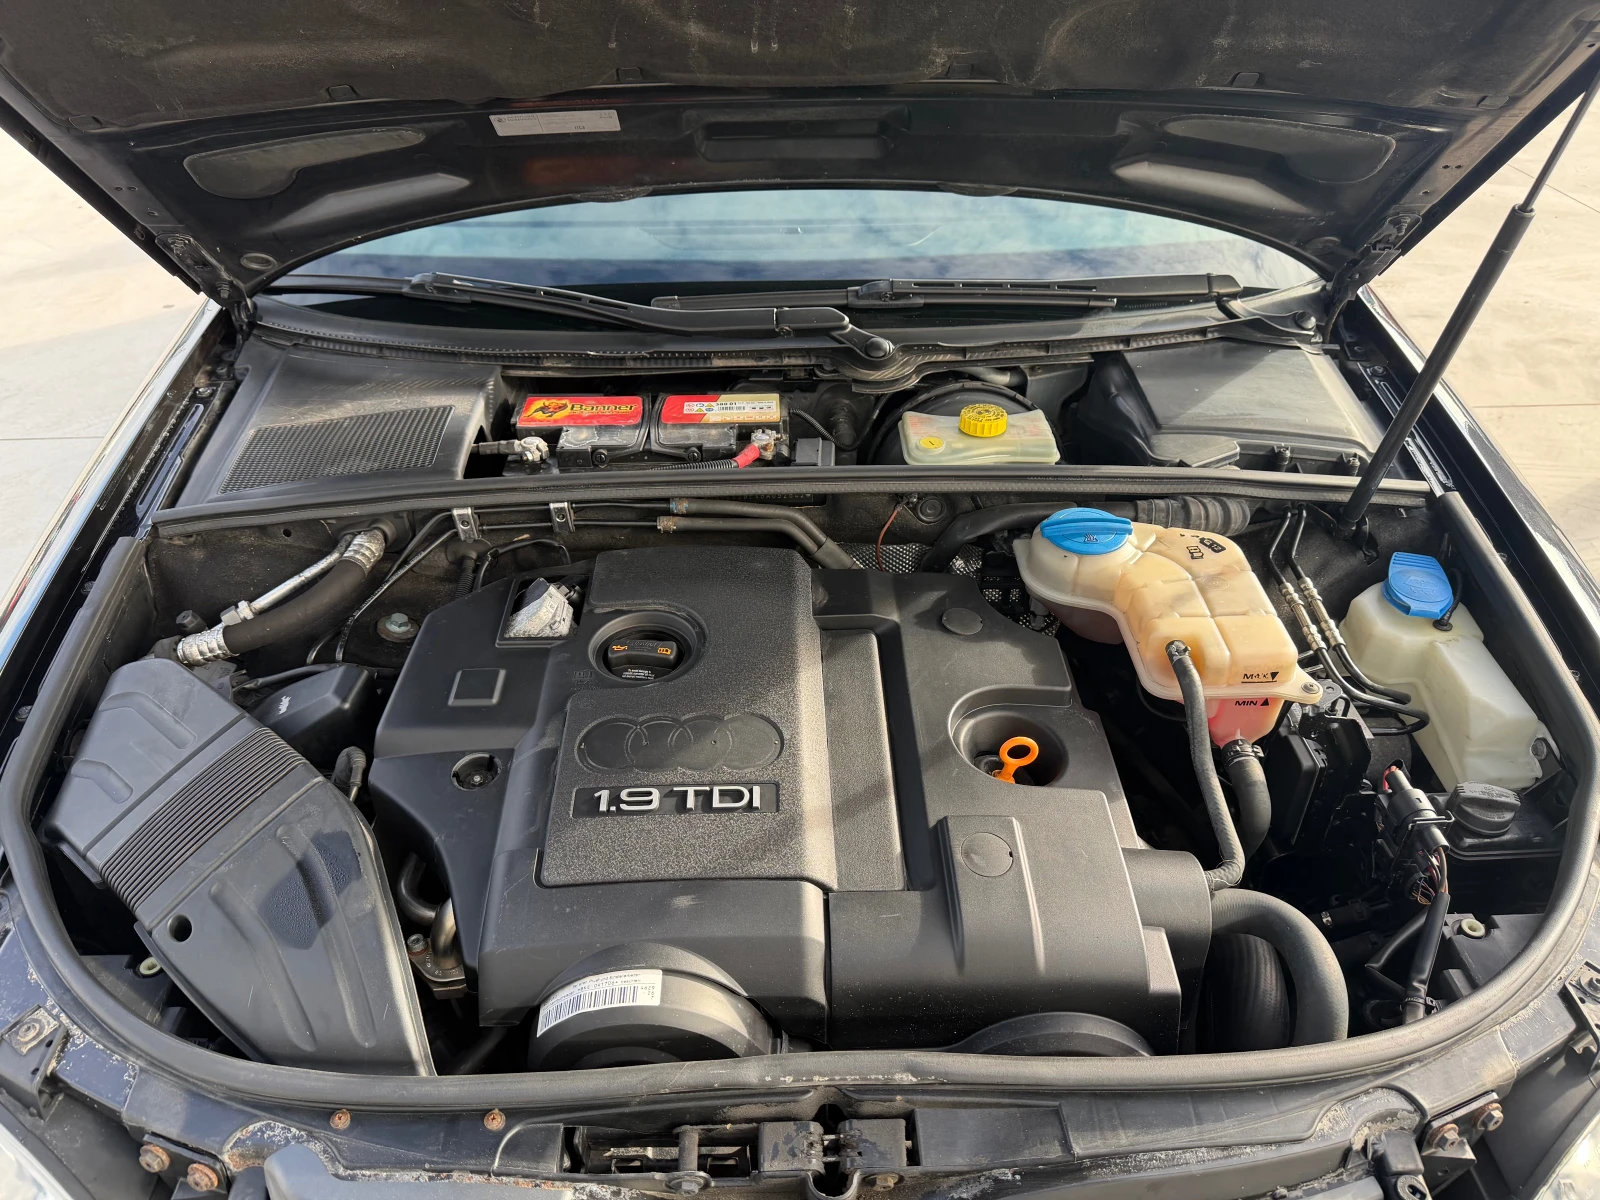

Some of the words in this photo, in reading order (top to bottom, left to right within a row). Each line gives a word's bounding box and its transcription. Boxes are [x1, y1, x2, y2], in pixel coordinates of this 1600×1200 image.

[570, 403, 638, 411] Banner
[594, 787, 660, 813] 1.9
[672, 785, 761, 811] TDI
